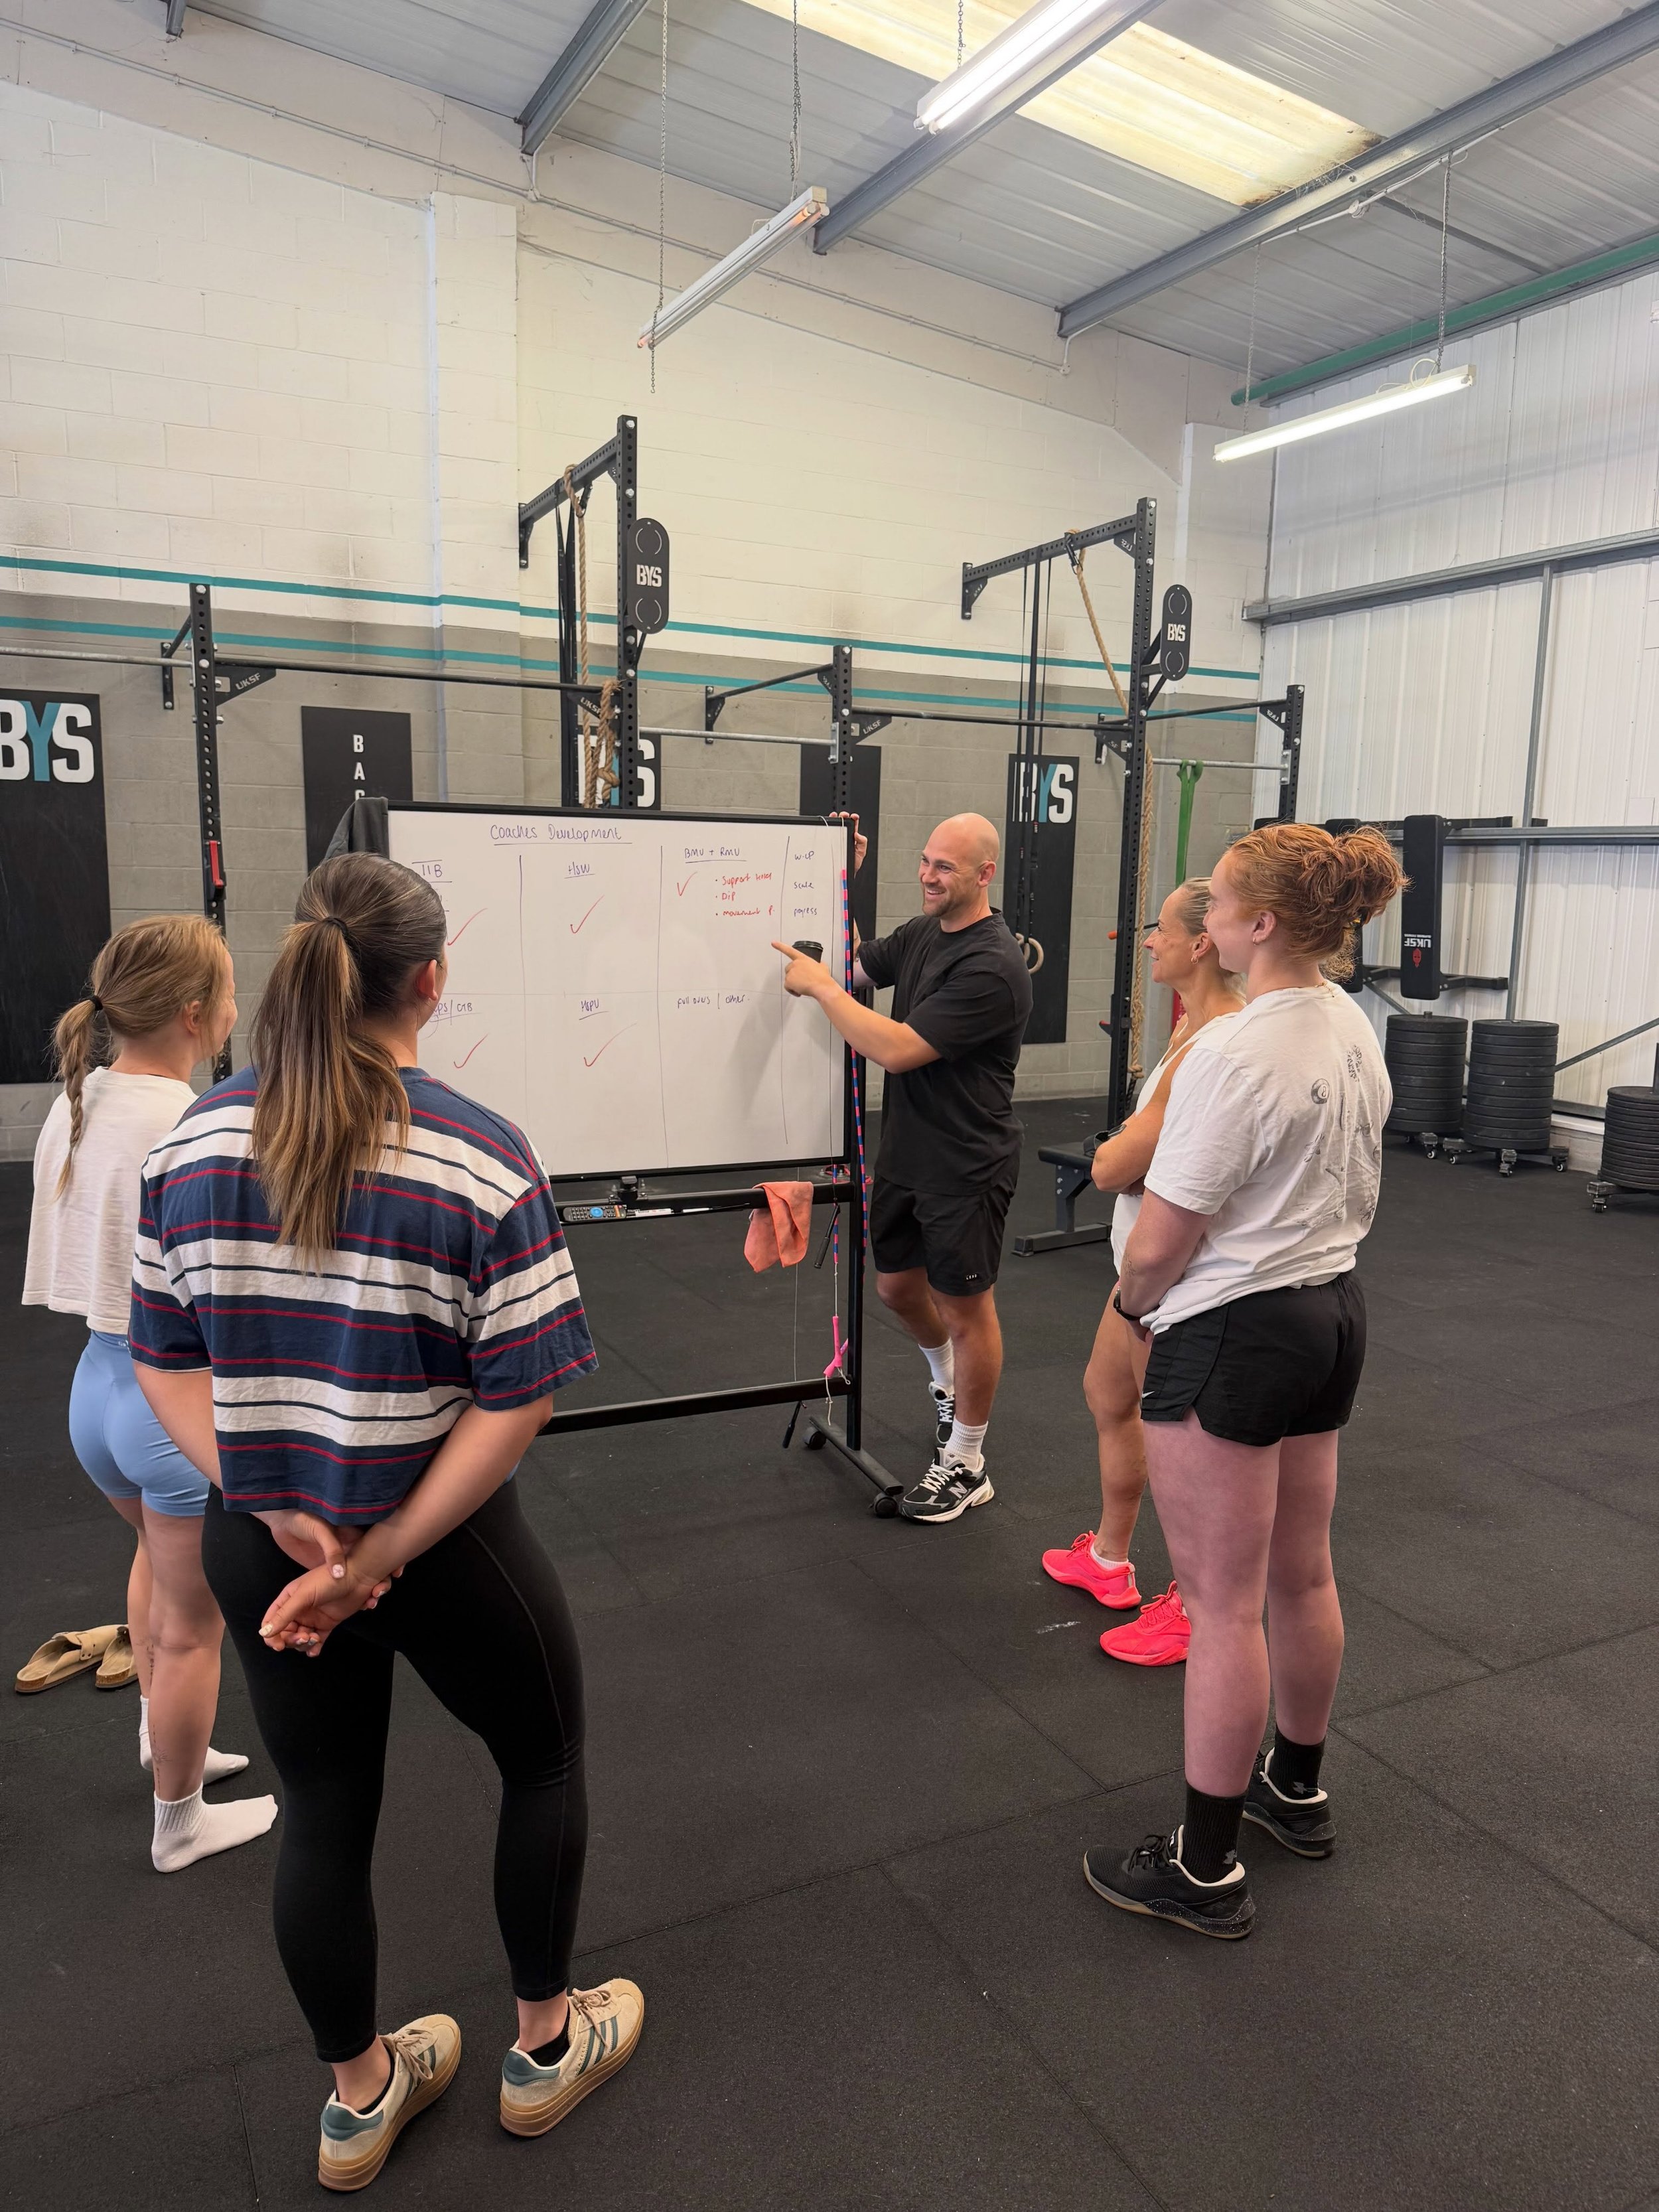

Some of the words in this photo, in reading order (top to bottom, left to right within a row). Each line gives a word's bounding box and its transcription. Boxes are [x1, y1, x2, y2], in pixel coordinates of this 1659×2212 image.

[636, 564, 662, 587] BYS
[1167, 623, 1186, 642] BYS
[236, 672, 261, 690] UKSF
[863, 719, 882, 735] UKSF
[0, 699, 95, 783] BYS
[490, 824, 538, 840] Coaches
[548, 824, 622, 842] Development
[684, 848, 704, 859] BMU
[1404, 937, 1431, 948] UKSF
